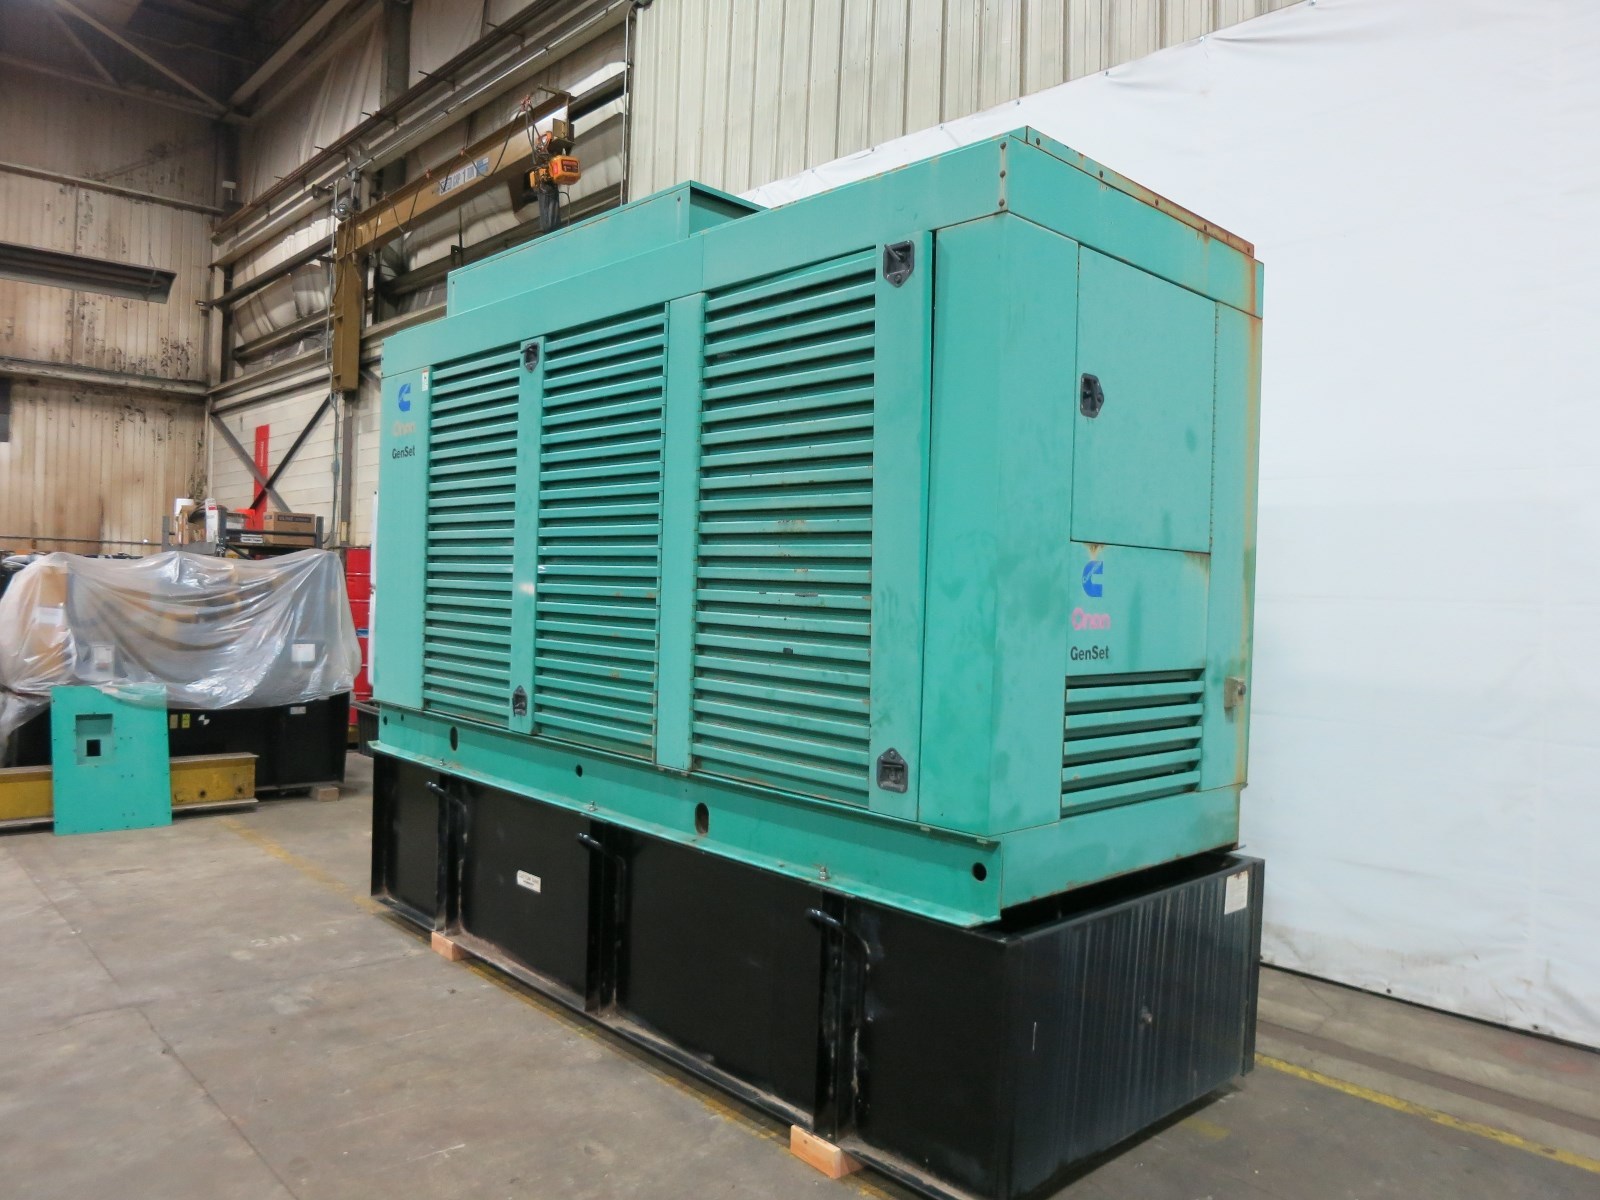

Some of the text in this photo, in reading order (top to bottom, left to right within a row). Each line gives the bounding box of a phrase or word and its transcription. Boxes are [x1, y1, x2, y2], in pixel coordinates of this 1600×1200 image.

[392, 445, 415, 459] GenSet
[1071, 607, 1111, 631] Onan
[1070, 645, 1109, 661] GenSet
